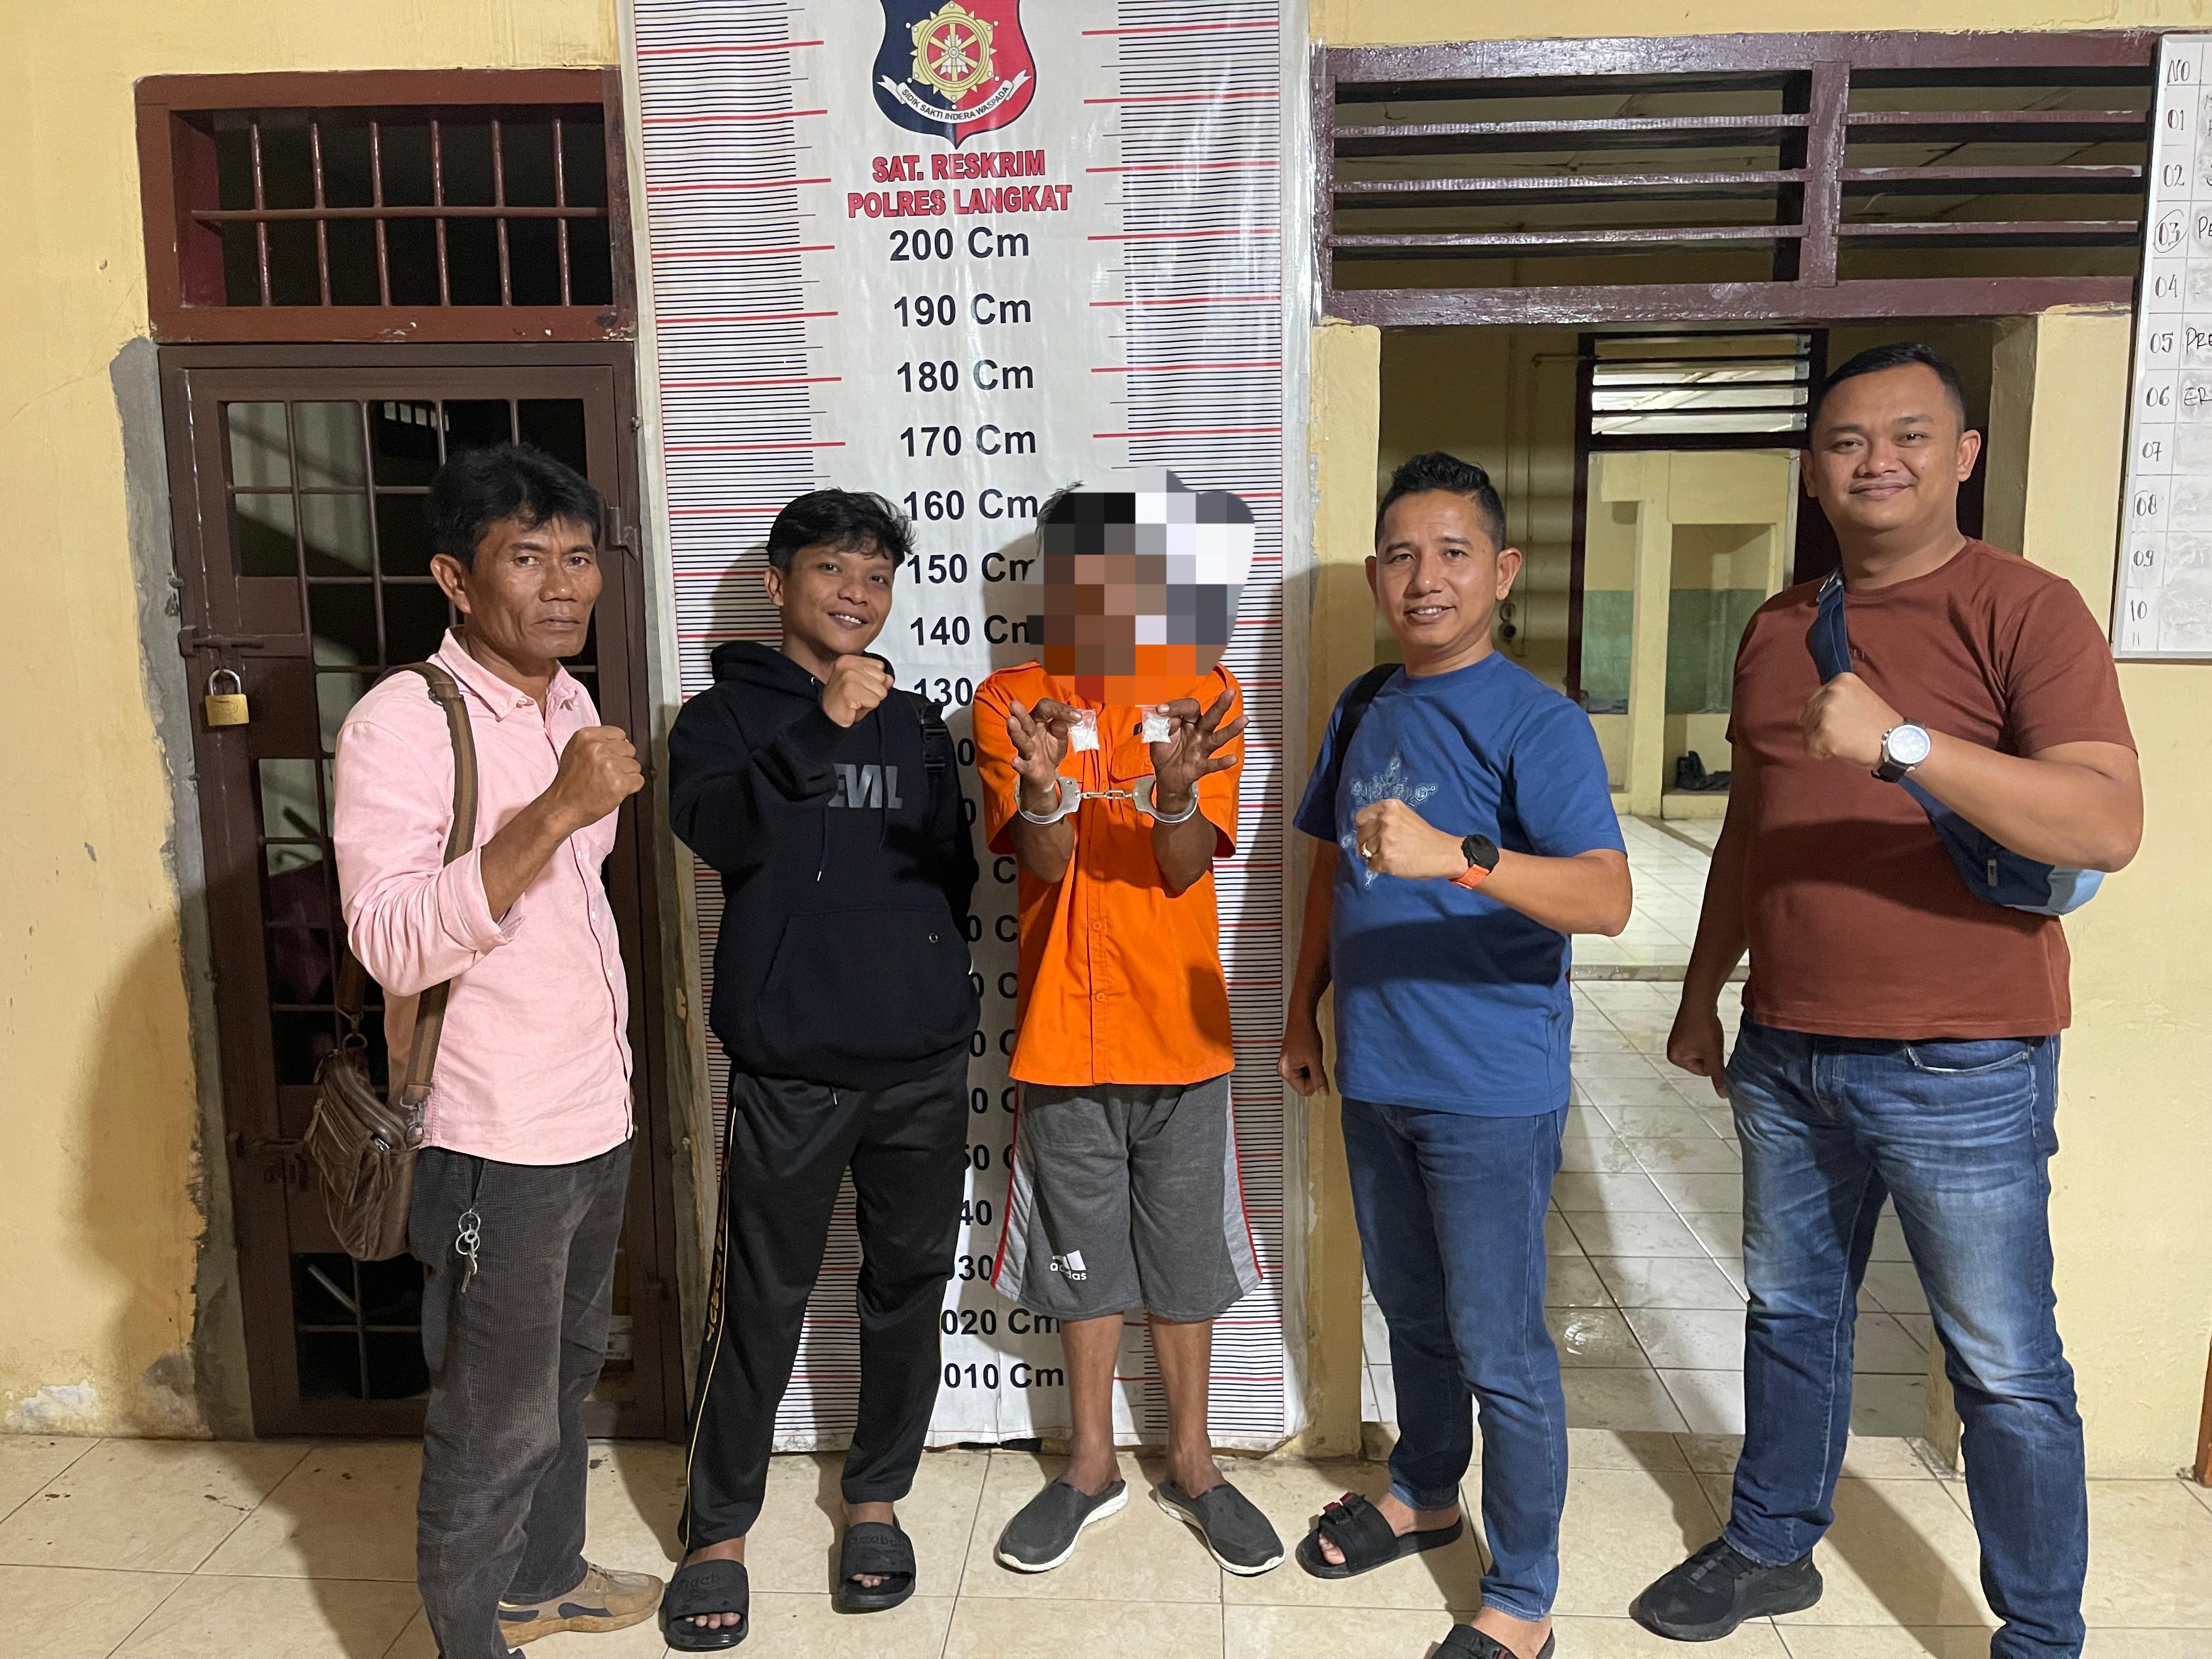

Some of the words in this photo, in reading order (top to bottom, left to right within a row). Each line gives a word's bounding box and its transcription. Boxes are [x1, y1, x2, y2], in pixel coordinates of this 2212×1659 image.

[2168, 59, 2190, 83] NO
[902, 89, 919, 108] SIDIK
[920, 104, 943, 119] SAKTI
[945, 111, 975, 120] INDERA
[976, 87, 1009, 115] WASPADA
[2168, 110, 2184, 131] 01
[872, 155, 923, 183] SAT.
[932, 150, 1045, 180] RESKRIM
[2163, 164, 2185, 187] 02
[848, 189, 945, 218] POLRES
[953, 184, 1072, 215] LANGKAT
[890, 228, 953, 261] 200
[968, 227, 1029, 258] Cm
[2159, 222, 2180, 247] 03
[2155, 274, 2178, 298] 04
[894, 295, 956, 326] 190
[971, 294, 1030, 325] Cm
[2150, 331, 2173, 353] 05
[898, 360, 958, 392] 180
[973, 359, 1034, 391] Cm
[2146, 386, 2169, 407] 06
[901, 426, 961, 457] 170
[976, 424, 1036, 455] Cm
[2142, 442, 2162, 461] 07
[904, 490, 964, 521] 160
[979, 489, 1037, 518] Cm
[2137, 494, 2157, 516] 08
[907, 554, 967, 584] 150
[2134, 550, 2154, 567] 09
[2131, 600, 2147, 622] 10
[911, 616, 970, 646] 140
[914, 678, 973, 707] 130
[961, 1200, 992, 1226] 40
[958, 1255, 993, 1280] 30
[941, 1310, 996, 1335] 020
[1008, 1308, 1060, 1334] Cm
[944, 1363, 998, 1389] 010
[1010, 1363, 1063, 1388] Cm
